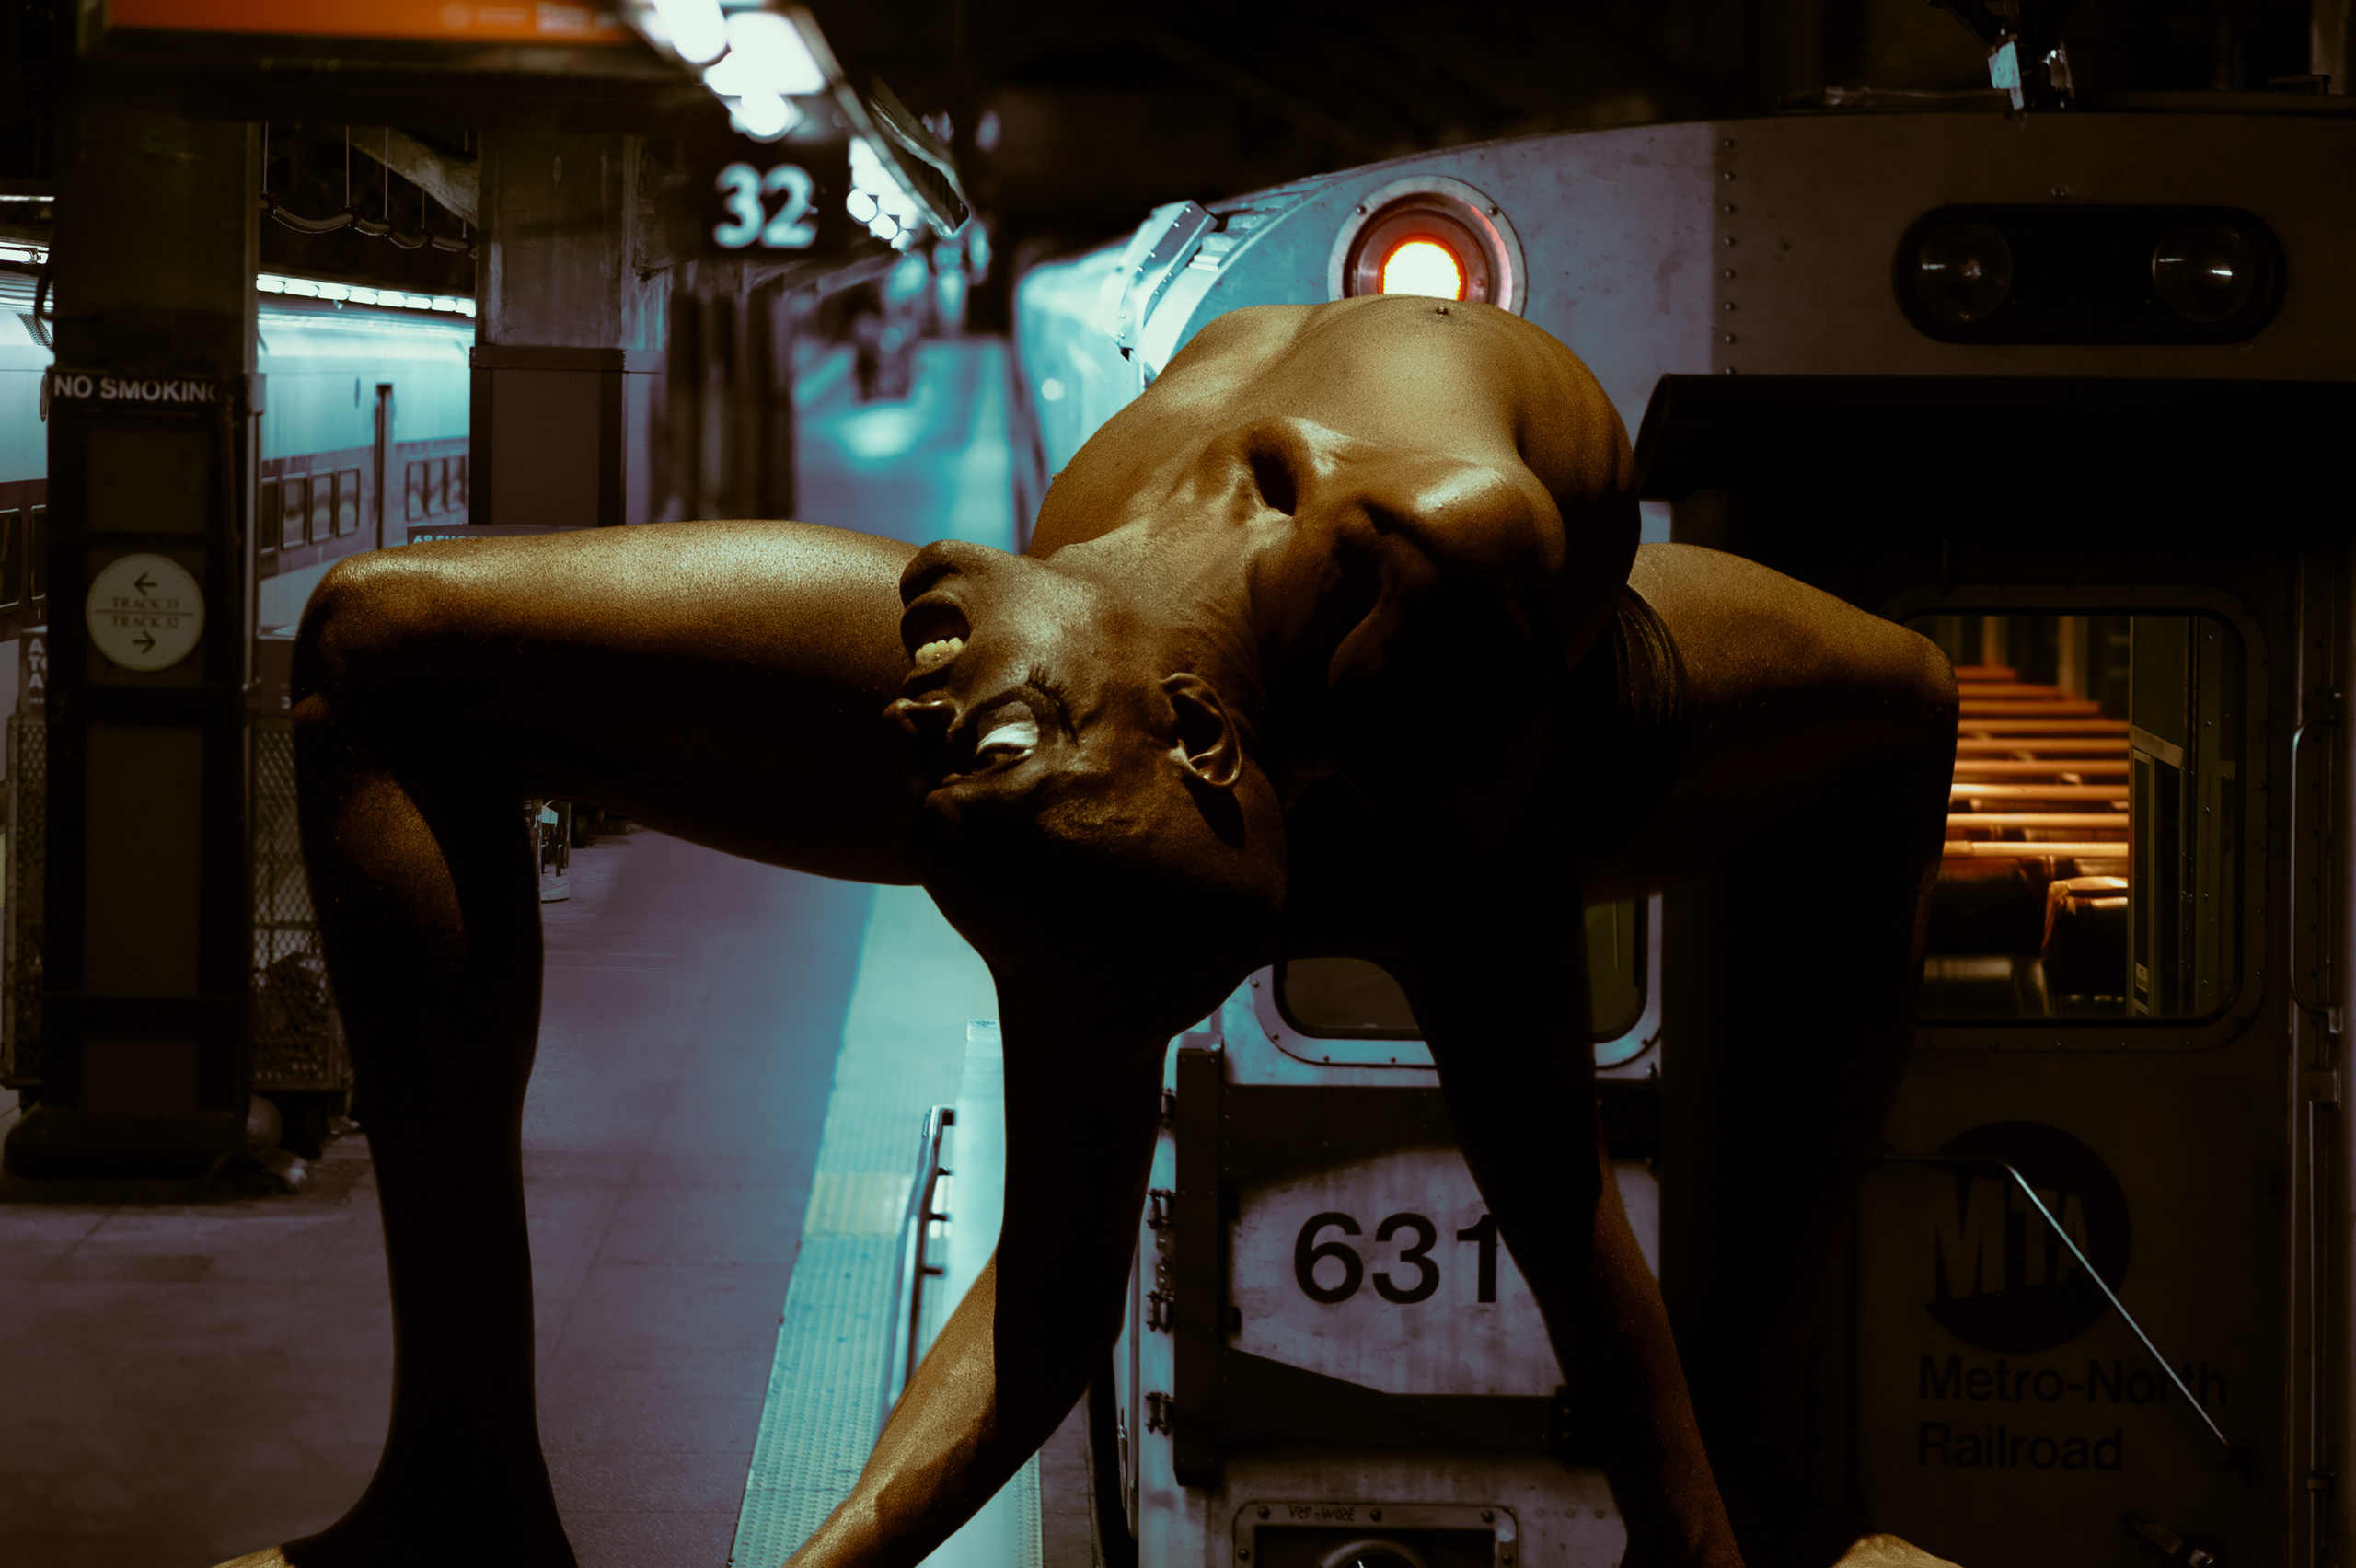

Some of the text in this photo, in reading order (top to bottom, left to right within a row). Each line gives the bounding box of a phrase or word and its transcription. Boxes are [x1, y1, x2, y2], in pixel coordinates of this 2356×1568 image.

[713, 162, 817, 248] 32
[54, 375, 93, 398] NO
[111, 596, 160, 608] TRACK
[111, 615, 160, 627] TRACK
[1294, 1212, 1497, 1304] 631
[1935, 1170, 2091, 1300] MTA
[1919, 1355, 2227, 1407] Metro-North
[1918, 1422, 2122, 1470] Railroad
